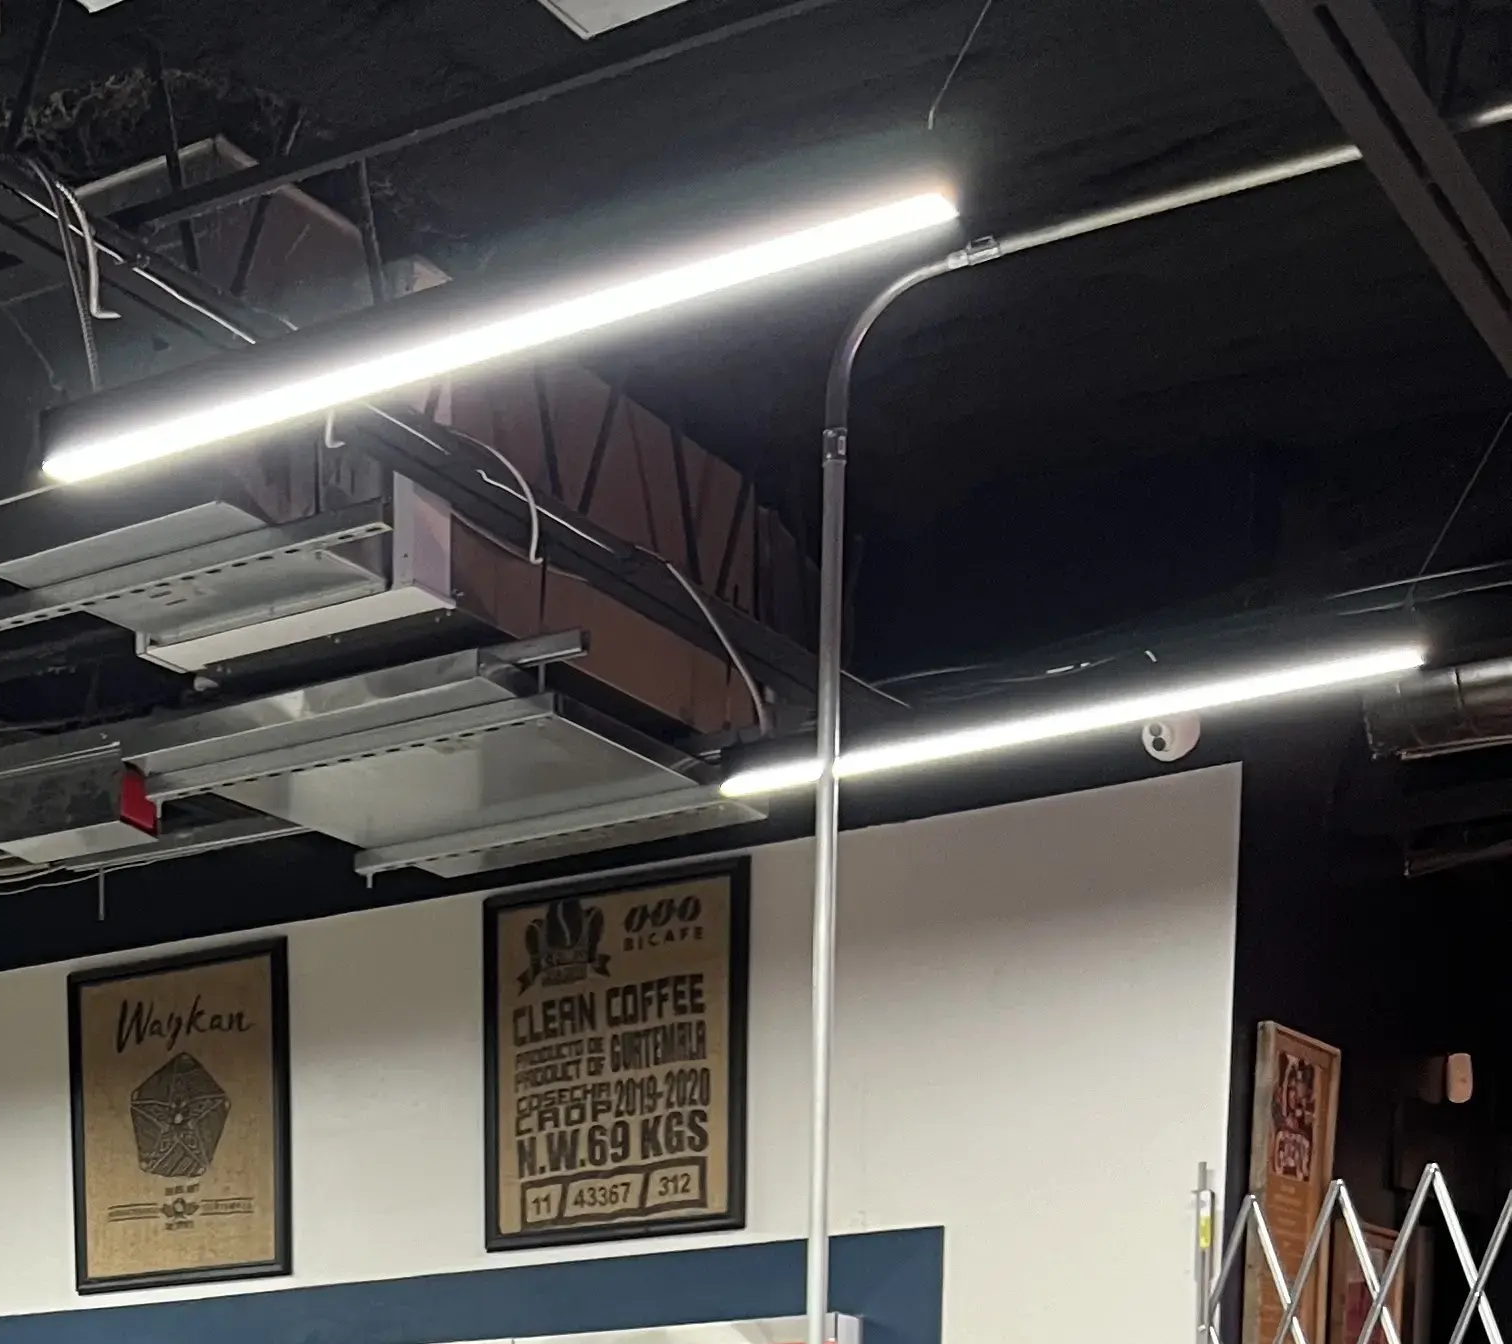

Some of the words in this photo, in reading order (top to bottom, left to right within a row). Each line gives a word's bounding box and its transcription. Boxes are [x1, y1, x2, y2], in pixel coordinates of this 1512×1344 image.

[623, 927, 704, 951] BICAFE
[116, 995, 254, 1052] Waykan
[513, 992, 595, 1046] CLEAN
[607, 973, 706, 1028] COFFEE
[516, 1040, 583, 1070] PRODUCTO
[589, 1037, 604, 1053] DE
[611, 1021, 707, 1072] GUATEMALA
[516, 1058, 582, 1093] PRODUCT
[587, 1057, 605, 1076] OF
[614, 1067, 710, 1118] 2019-2020
[516, 1082, 611, 1115] COSECHA
[641, 1110, 709, 1160] KGS
[532, 1194, 551, 1215] 11
[574, 1182, 631, 1208] 43367
[658, 1173, 690, 1196] 312
